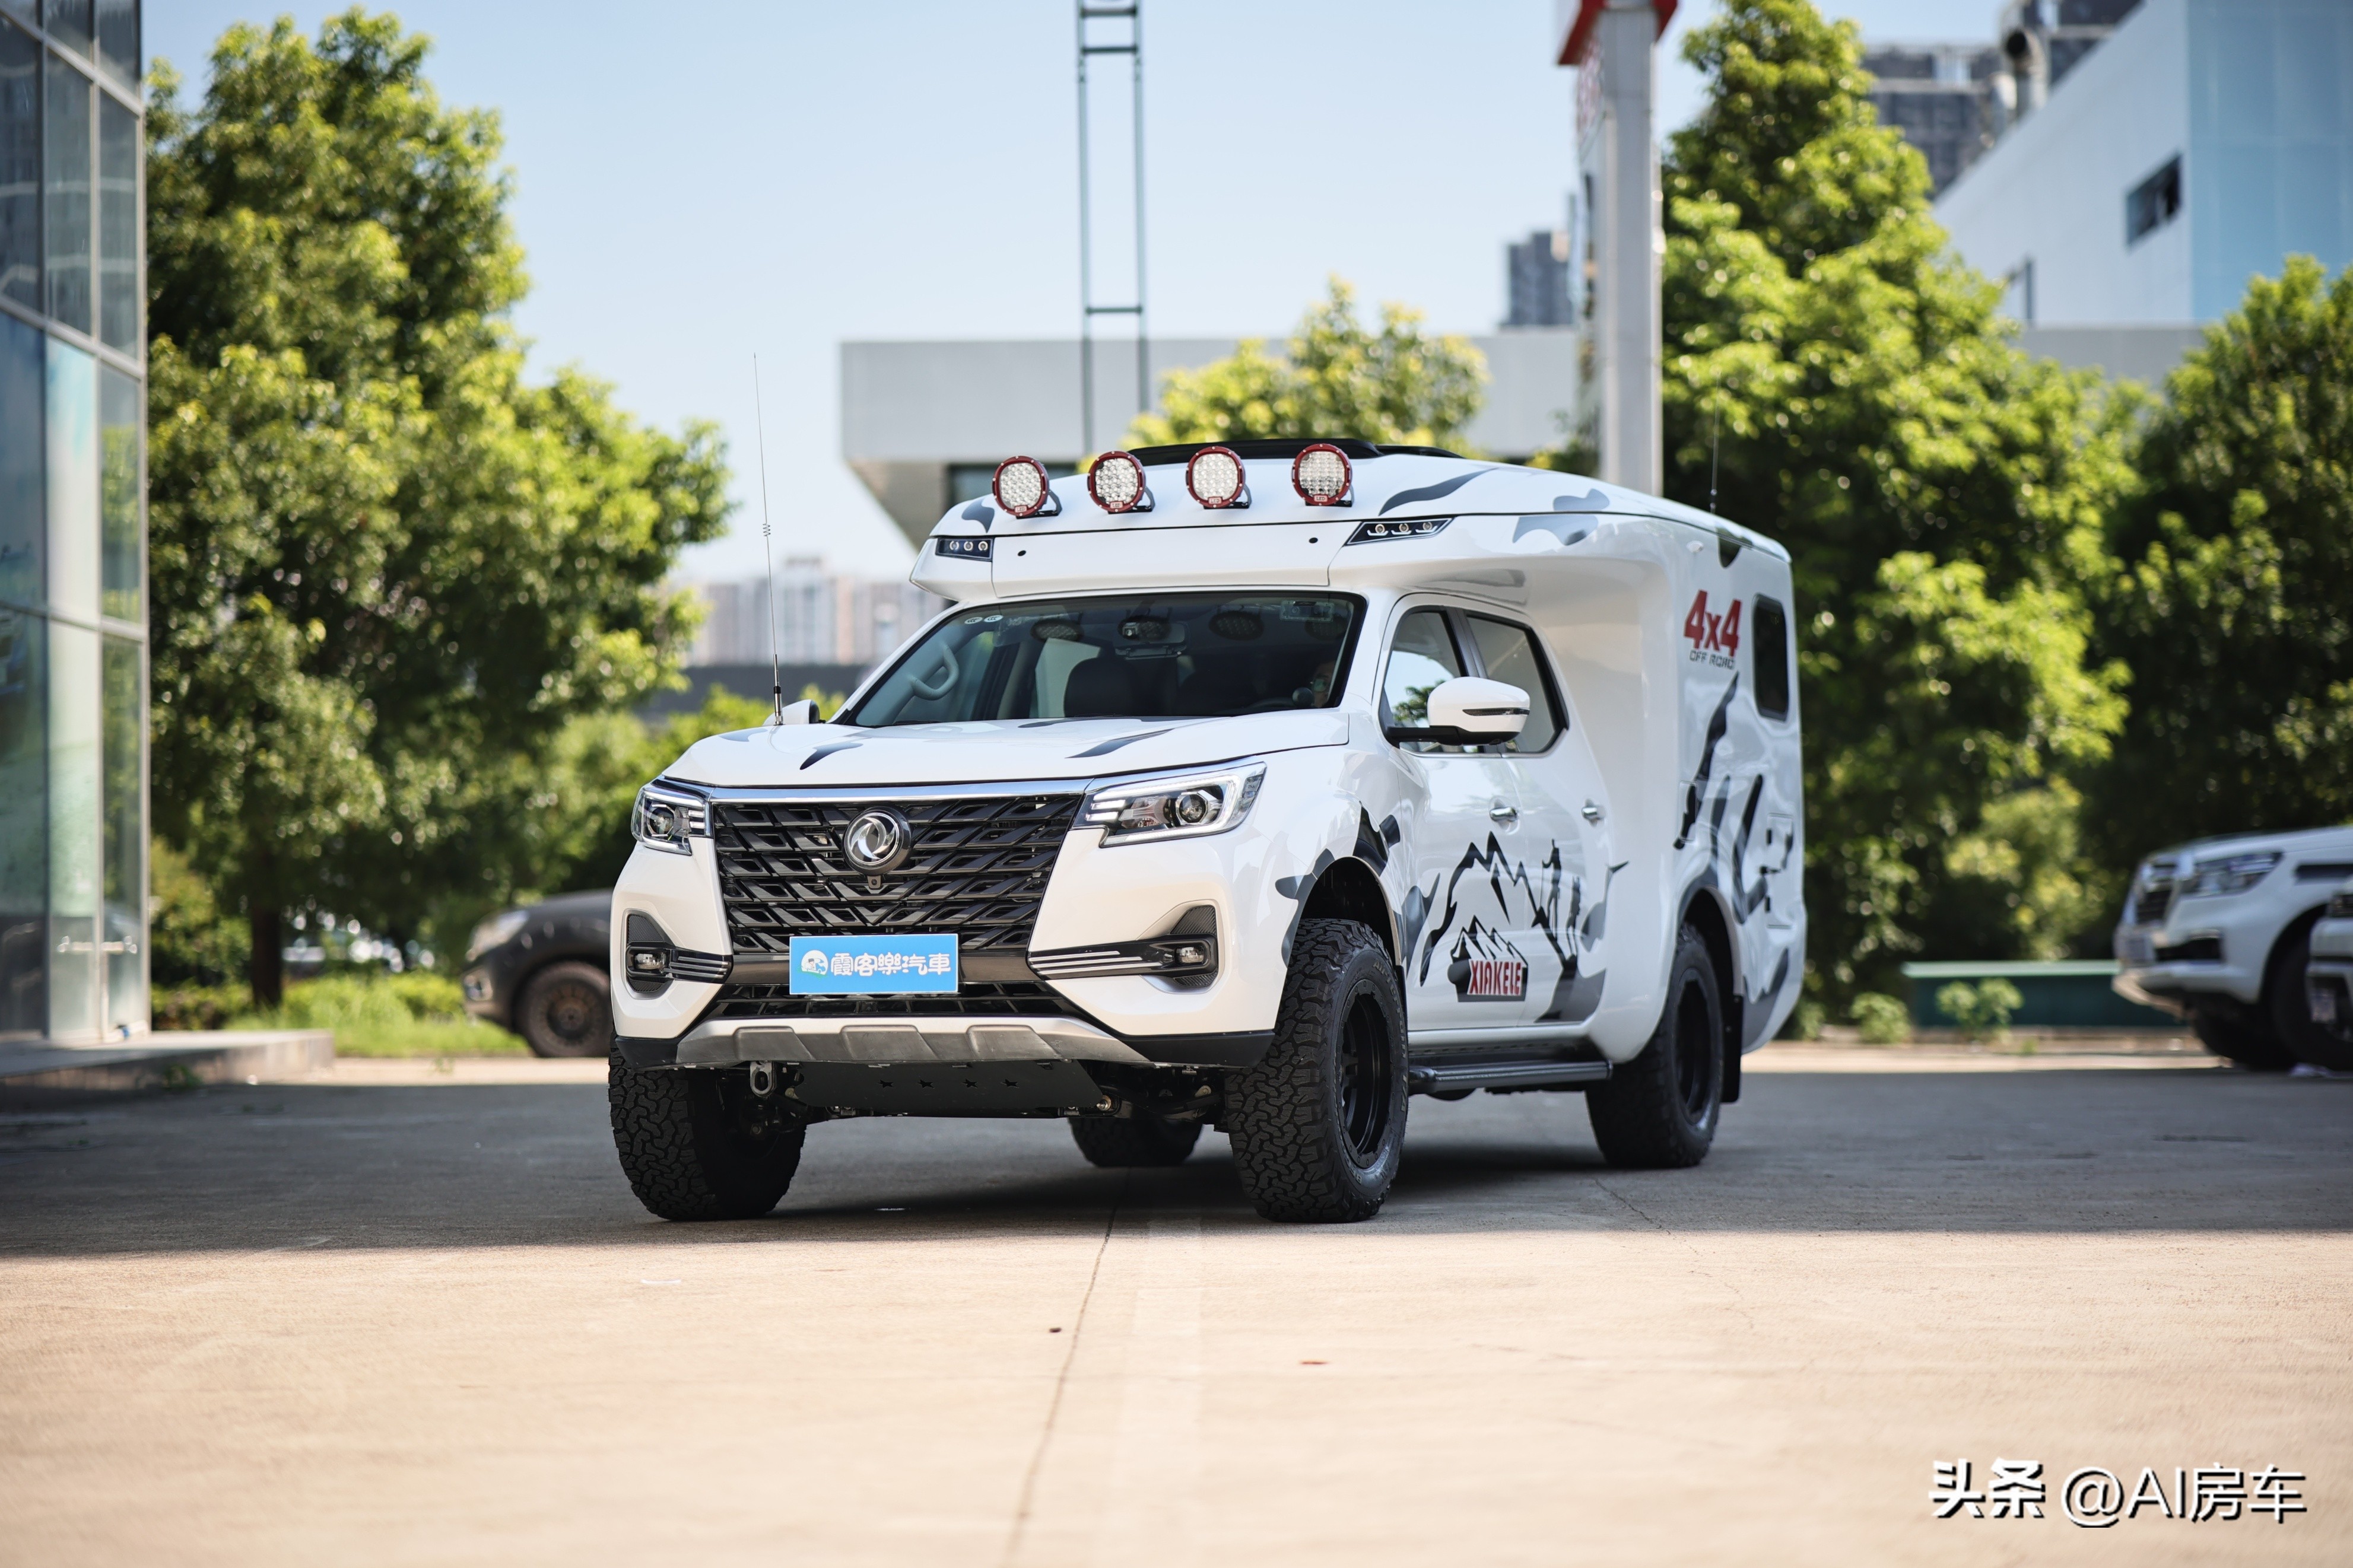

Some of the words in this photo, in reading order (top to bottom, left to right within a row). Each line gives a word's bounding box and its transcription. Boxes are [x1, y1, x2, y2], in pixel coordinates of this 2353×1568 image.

[1690, 650, 1707, 662] OFF
[1709, 654, 1735, 670] ROAD
[831, 952, 951, 977] 霞客樂汽車
[1469, 960, 1522, 995] XIAKELE
